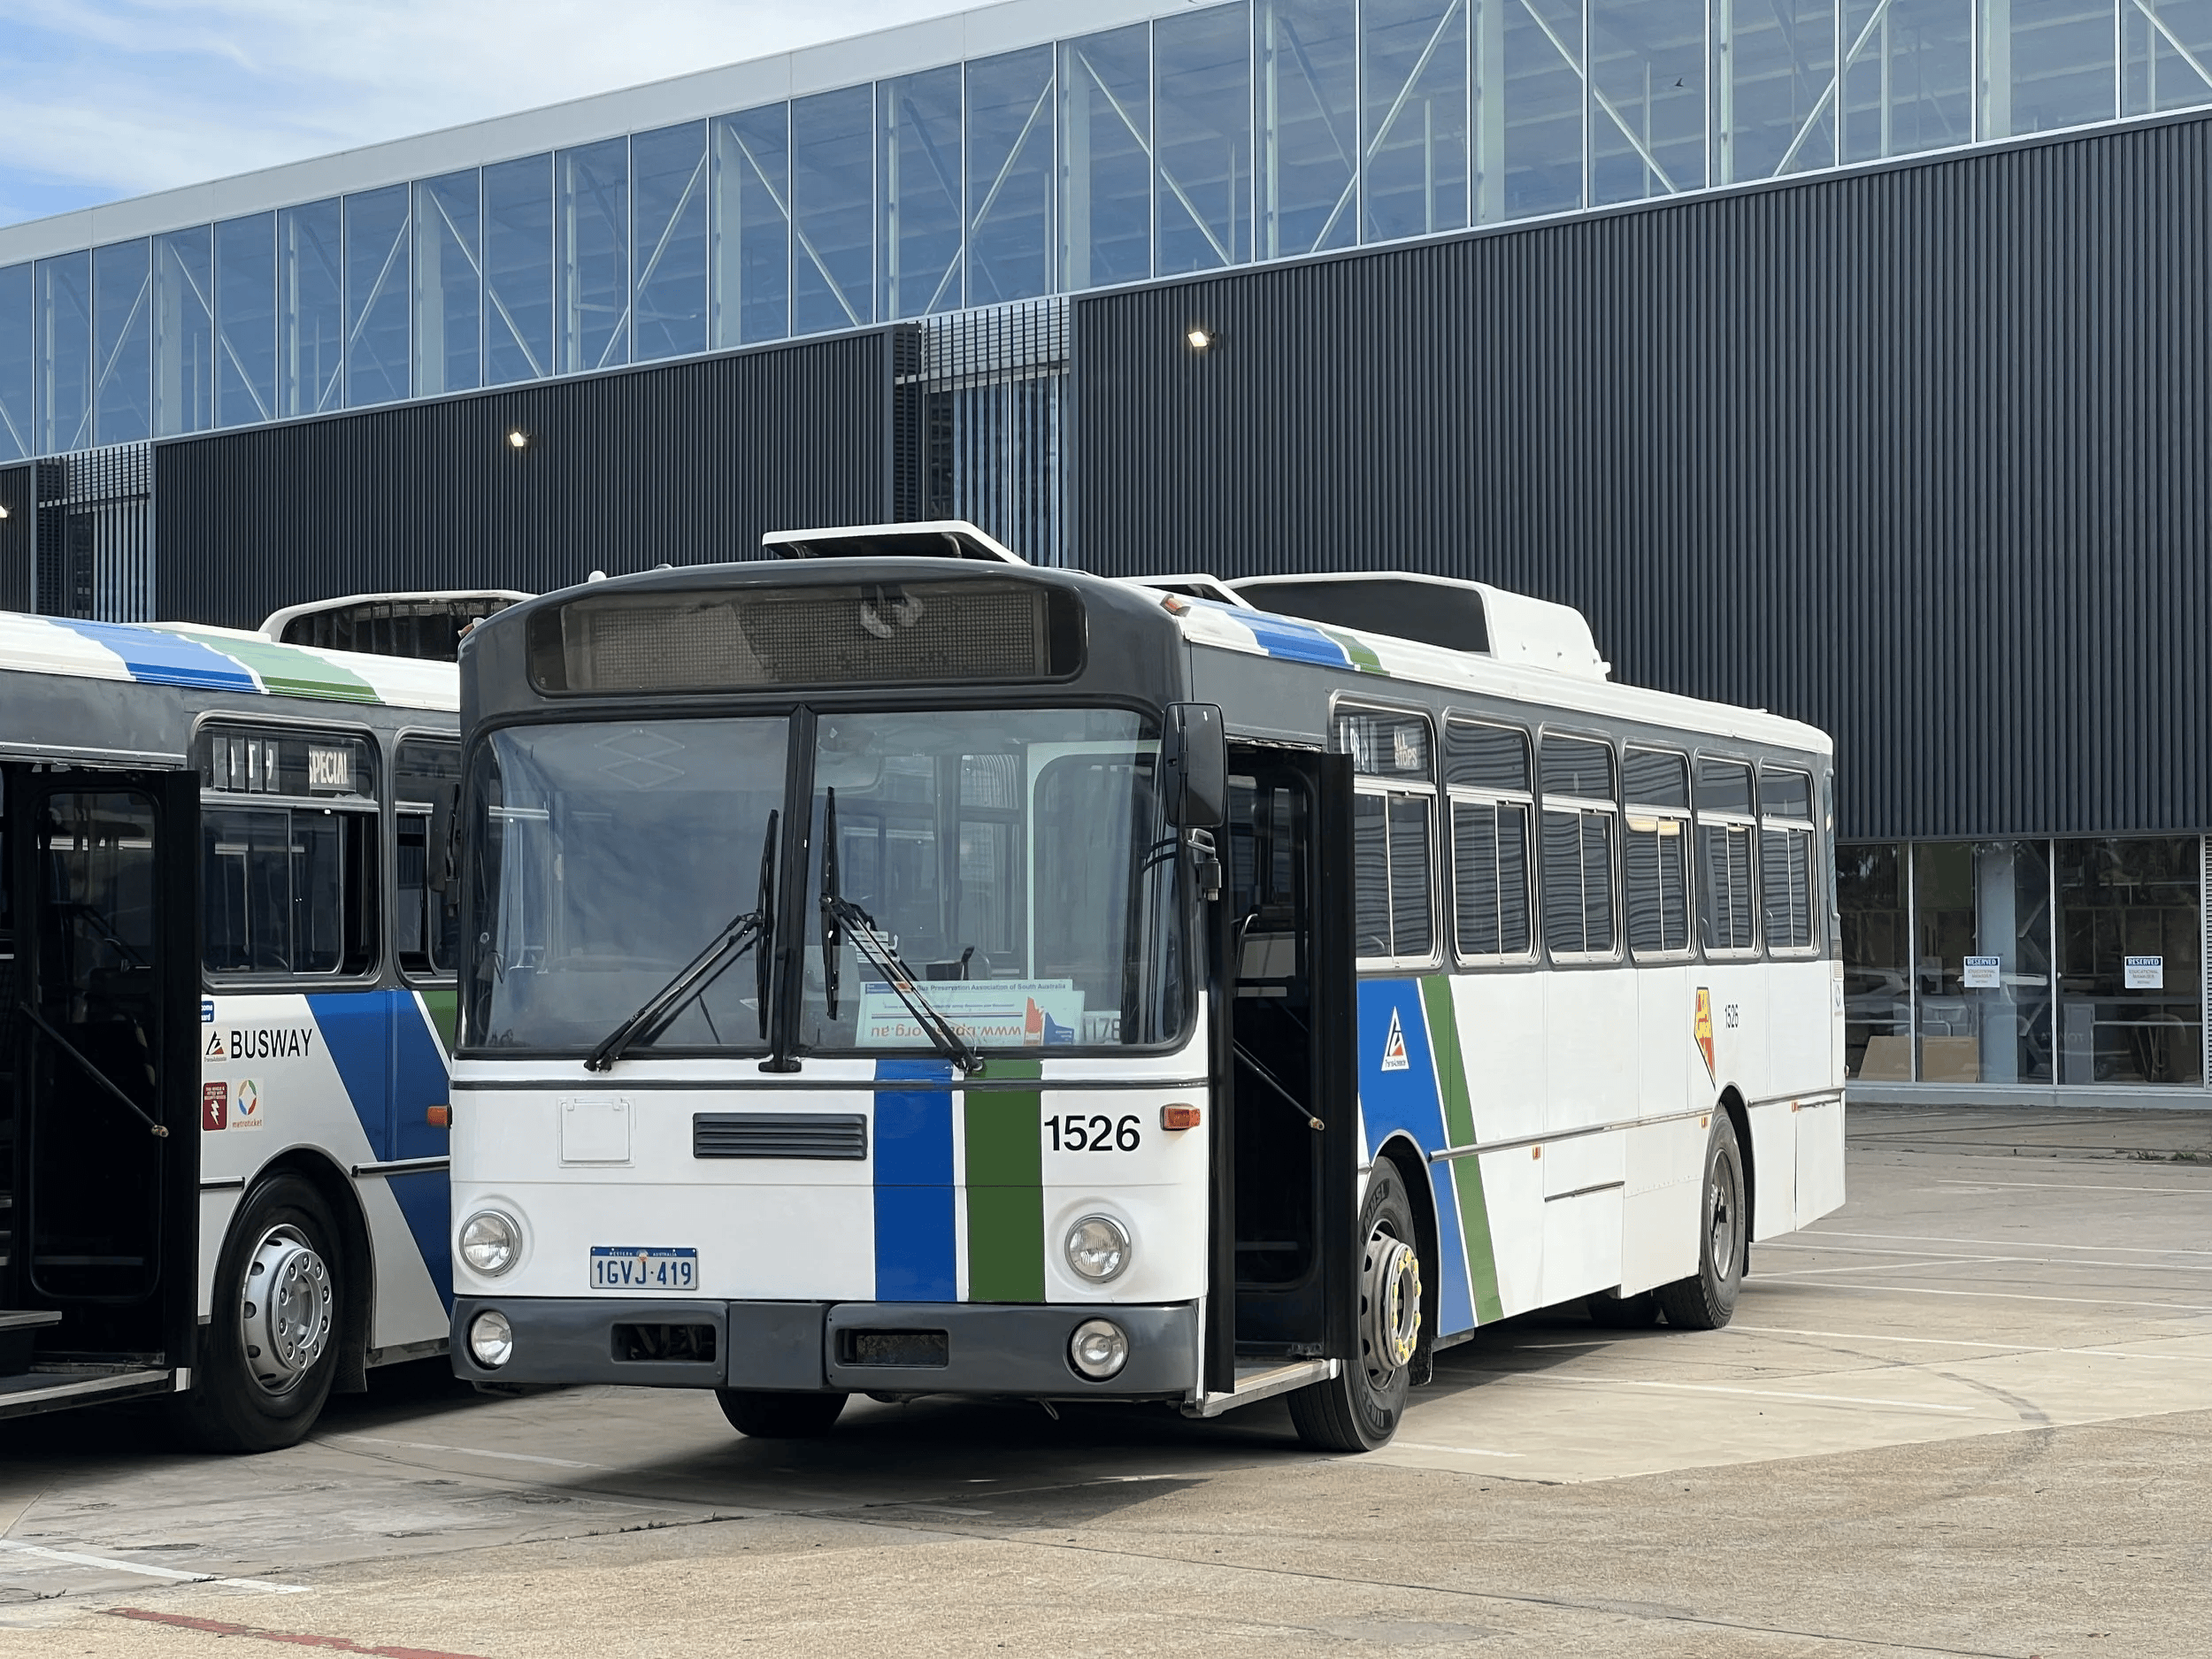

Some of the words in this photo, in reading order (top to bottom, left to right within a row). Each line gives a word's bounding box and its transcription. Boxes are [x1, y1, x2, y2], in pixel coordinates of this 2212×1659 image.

[1394, 732, 1408, 751] ALL
[309, 750, 349, 785] SPECIAL
[1394, 748, 1417, 767] STOPS
[1724, 1003, 1739, 1028] 1526
[231, 1028, 312, 1059] BUSWAY
[232, 1118, 263, 1128] metroticket
[1044, 1115, 1141, 1151] 1526
